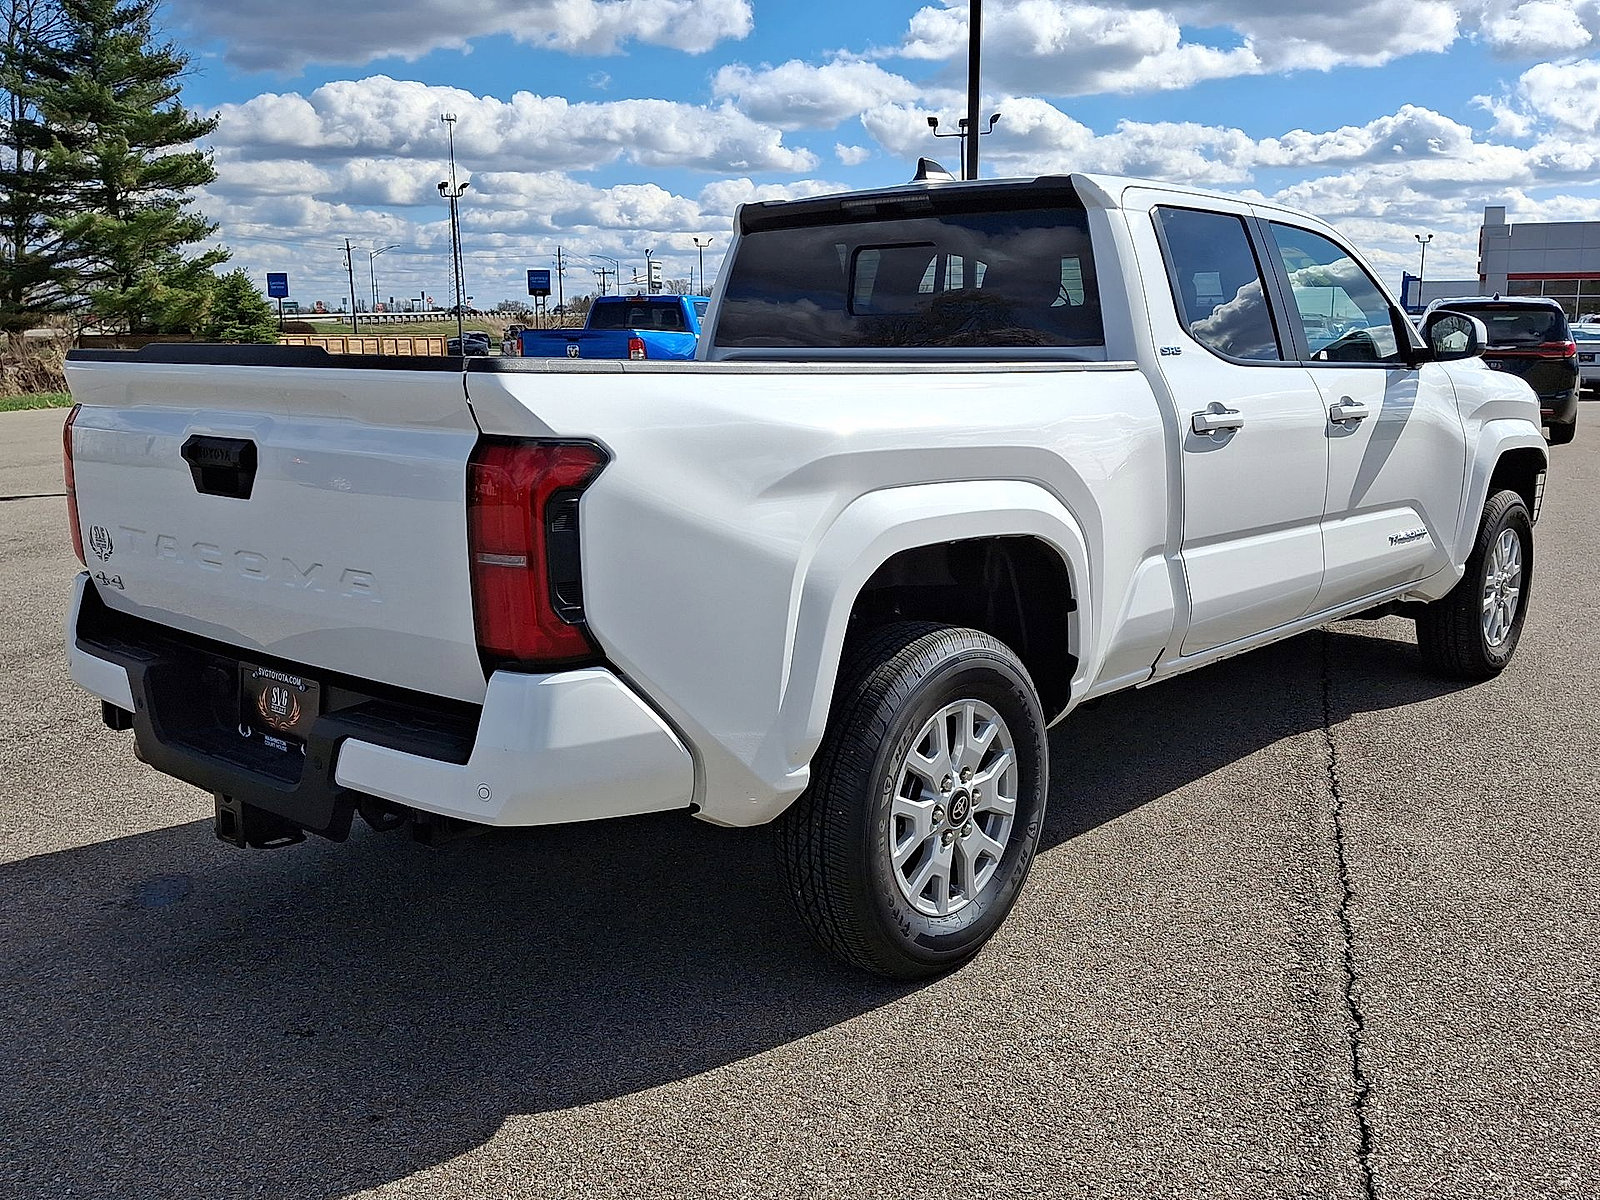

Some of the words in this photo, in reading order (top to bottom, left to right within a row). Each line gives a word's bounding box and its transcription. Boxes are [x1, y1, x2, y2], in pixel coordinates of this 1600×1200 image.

[118, 523, 385, 605] TACOMA
[258, 667, 303, 687] SVGTOYOTA.COM
[271, 686, 289, 706] SVG
